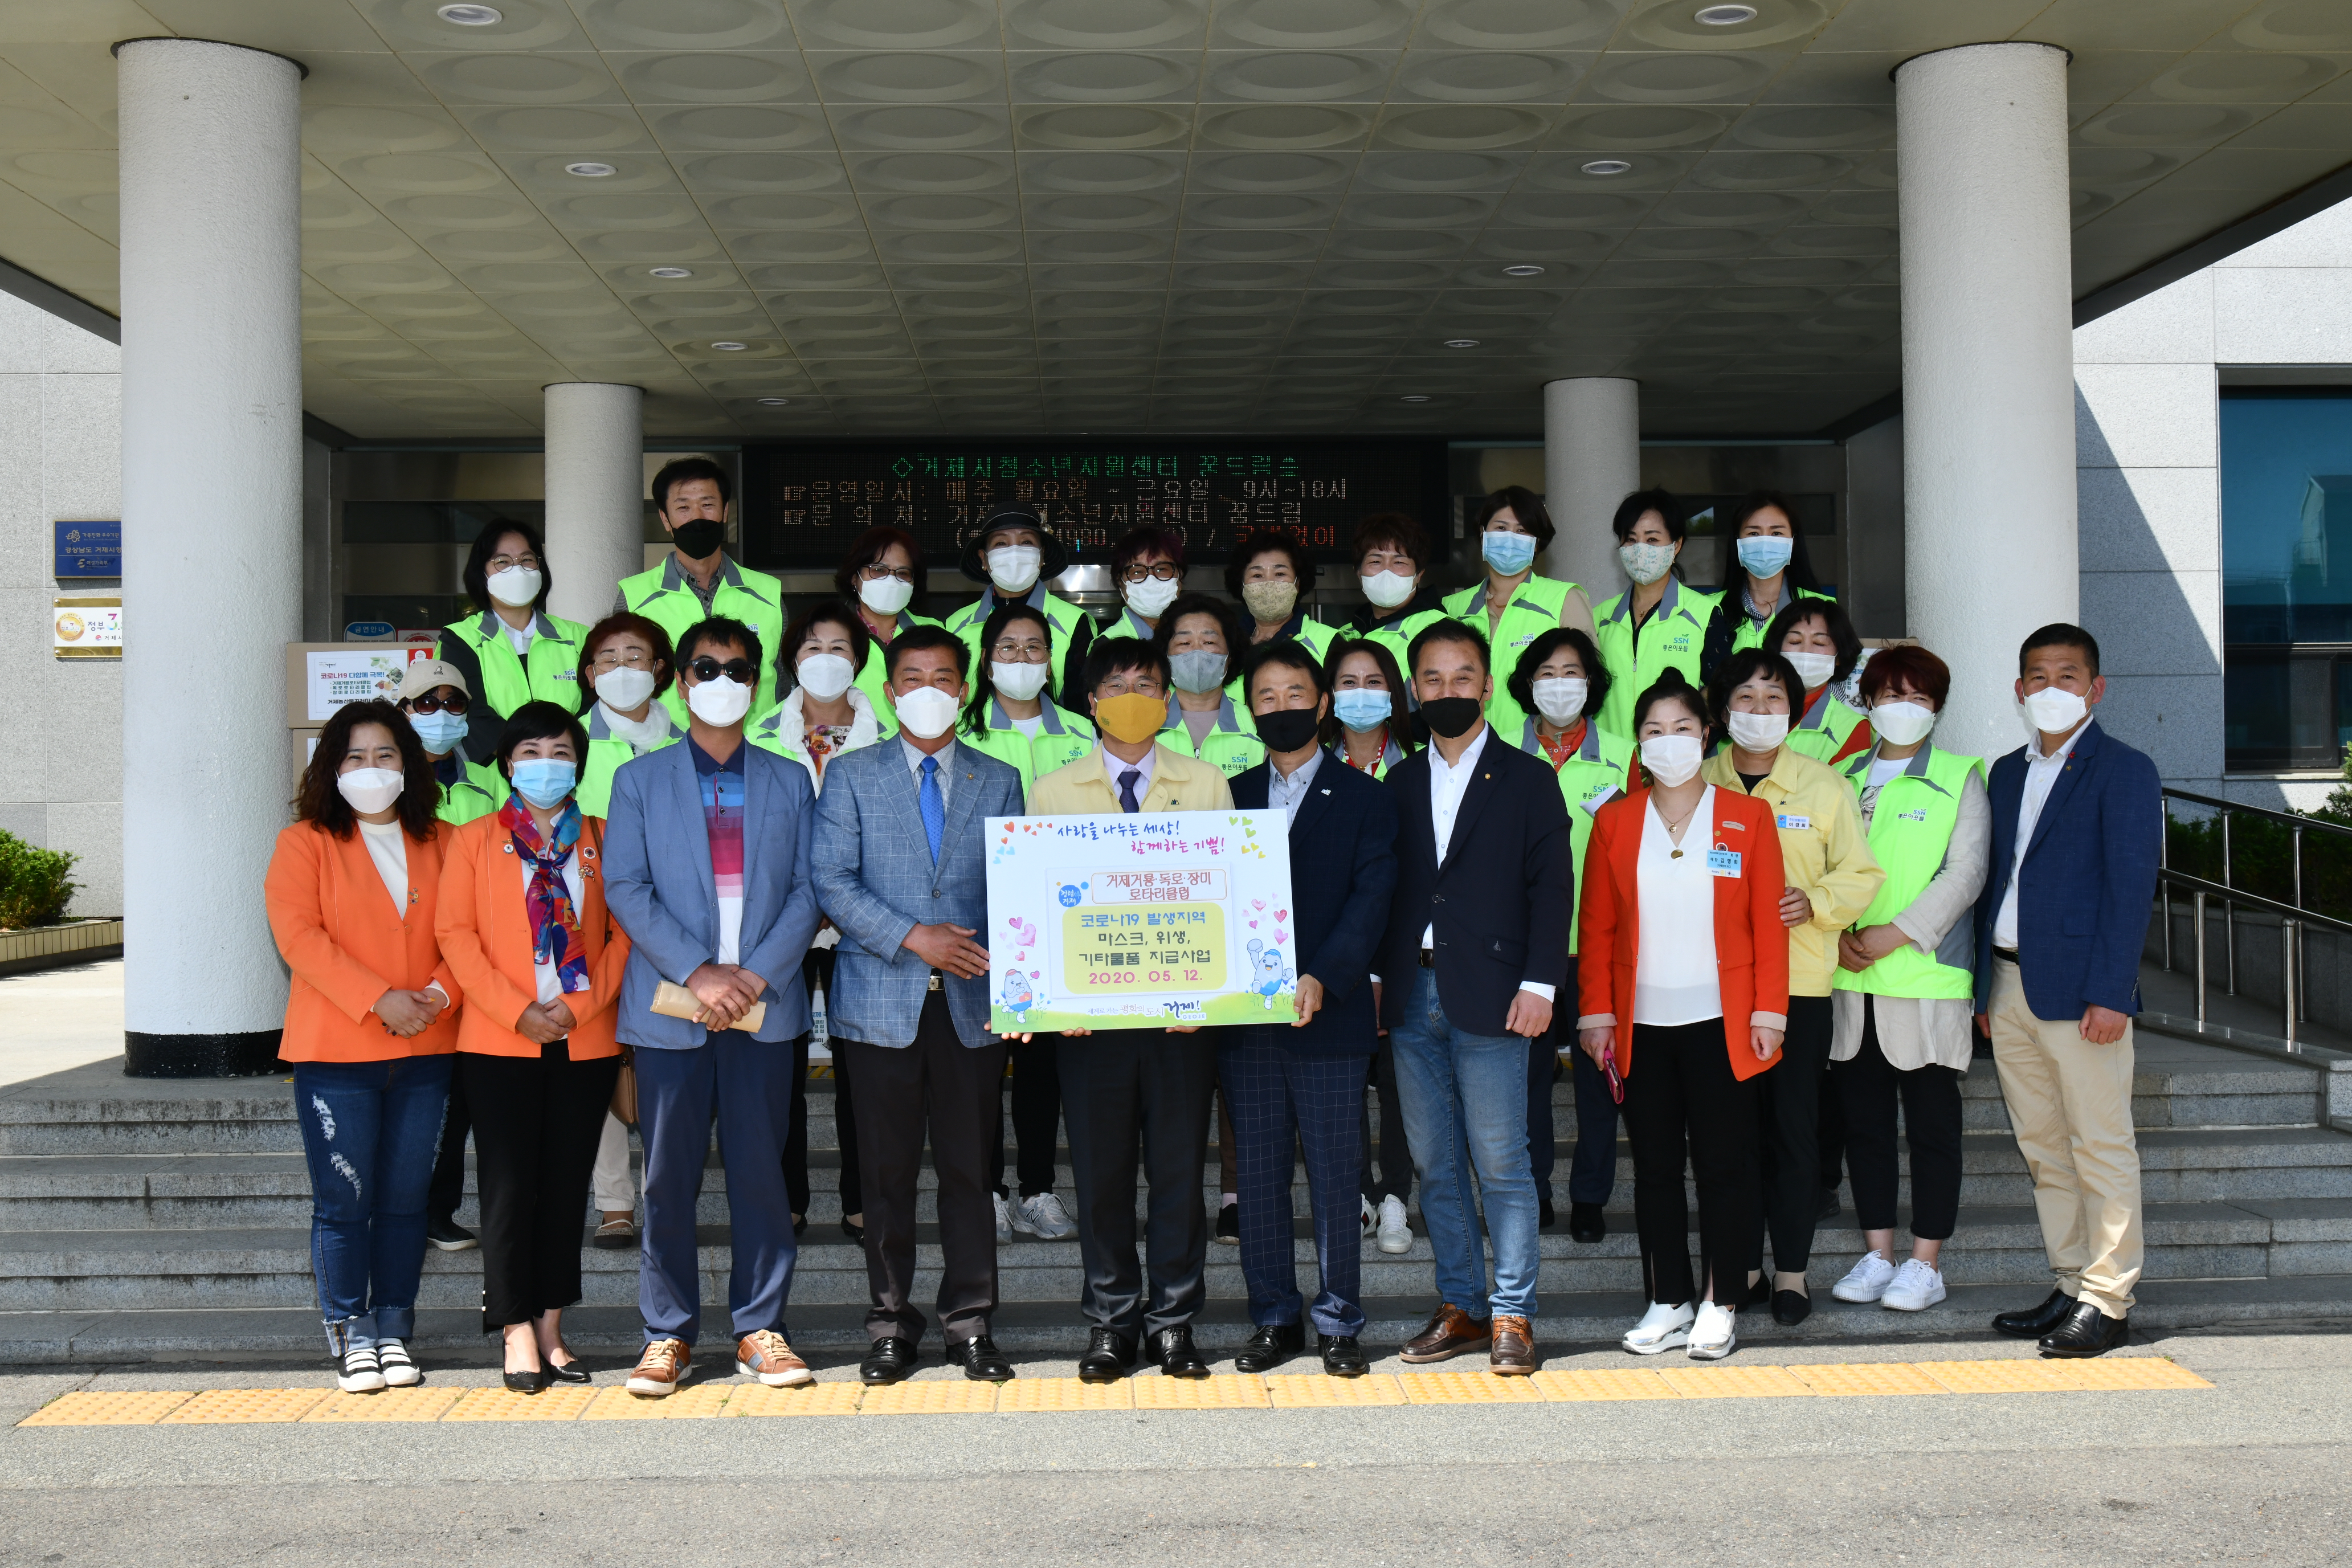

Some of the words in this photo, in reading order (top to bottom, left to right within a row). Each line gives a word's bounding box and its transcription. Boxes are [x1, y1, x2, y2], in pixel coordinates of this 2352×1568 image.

[1198, 455, 1271, 476] 꿈드림
[946, 480, 994, 501] 매주
[1015, 479, 1087, 501] 월요일
[1228, 501, 1301, 524] 꿈드림
[1057, 822, 1099, 840] 사랑을
[1104, 823, 1139, 837] 나누는
[1144, 820, 1179, 835] 세상!
[1131, 839, 1189, 855] 함께하는
[1194, 836, 1224, 855] 기쁨!
[1129, 887, 1190, 901] 로타리클럽
[1081, 913, 1140, 927] 코로나19
[1147, 911, 1206, 925] 발생지역
[1098, 932, 1148, 946] 마스크,
[1156, 930, 1190, 945] 위생,
[1079, 952, 1140, 966] 기타물품
[1149, 949, 1211, 964] 지급사업
[1089, 971, 1141, 985] 2020.
[1148, 970, 1175, 982] 05.
[1183, 969, 1203, 981] 12.
[1120, 1004, 1145, 1014] 평화의
[1146, 1006, 1164, 1016] 도시
[1163, 1000, 1200, 1018] 거제!
